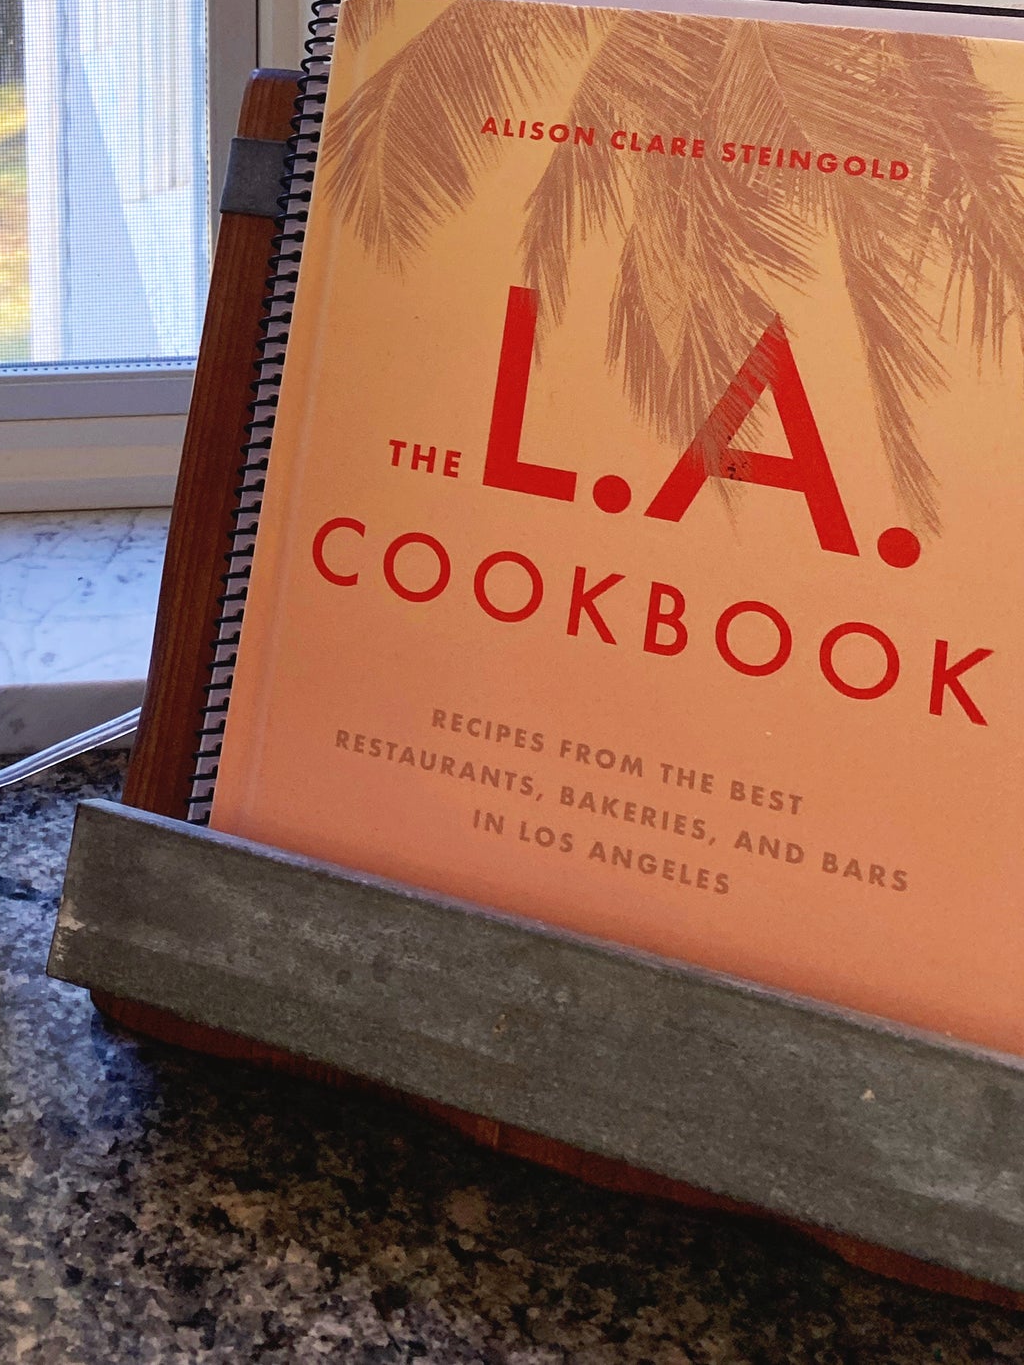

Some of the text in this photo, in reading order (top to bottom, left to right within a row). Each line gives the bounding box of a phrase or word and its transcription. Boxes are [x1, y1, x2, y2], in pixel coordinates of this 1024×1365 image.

[480, 117, 910, 181] ALISON CLARE STEINGOLD
[389, 285, 922, 569] THE L.A.
[311, 517, 994, 727] COOKBOOK
[335, 729, 908, 892] RESTAURANTS, BAKERIES, AND BARS
[432, 708, 803, 815] RECIPES FROM THE BEST
[473, 809, 729, 894] IN LOS ANGELES
